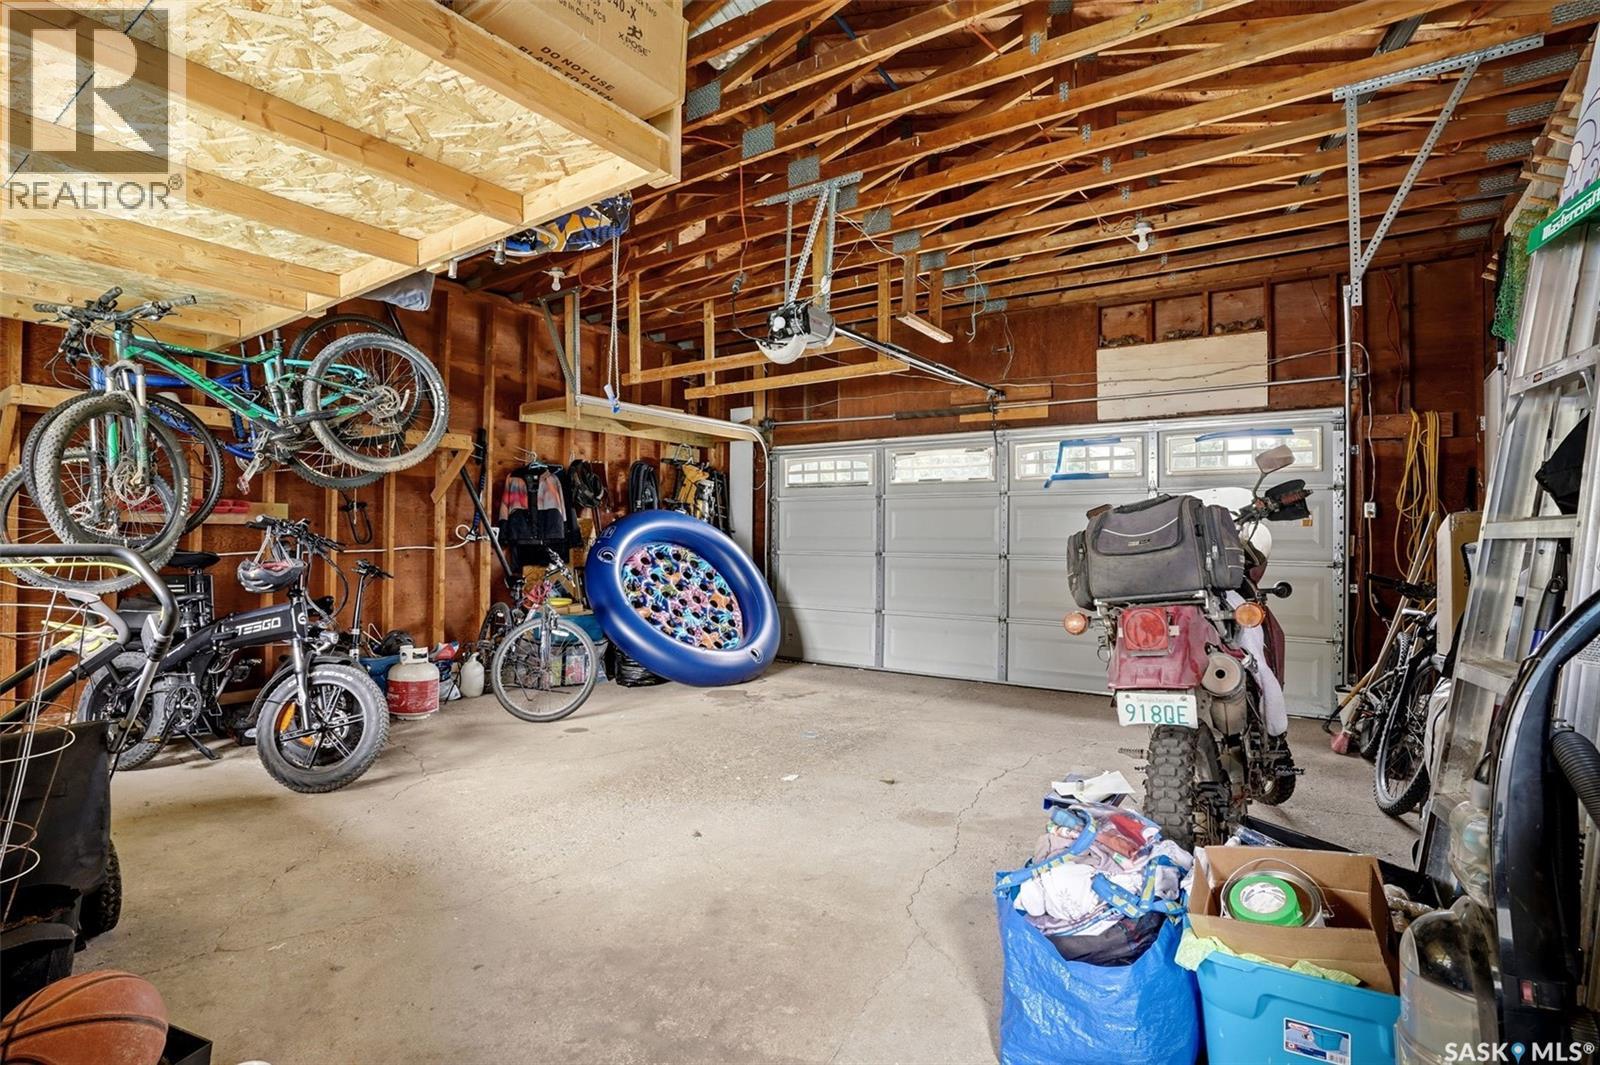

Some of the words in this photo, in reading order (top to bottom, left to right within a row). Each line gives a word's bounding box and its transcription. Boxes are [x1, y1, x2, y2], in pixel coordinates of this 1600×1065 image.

[575, 7, 594, 26] China
[593, 9, 606, 23] PCS
[618, 31, 650, 57] XPOSE
[540, 46, 561, 60] DO
[561, 58, 590, 75] NOT
[589, 75, 615, 91] USE
[235, 616, 281, 636] TESGO
[1125, 703, 1189, 725] 918QE
